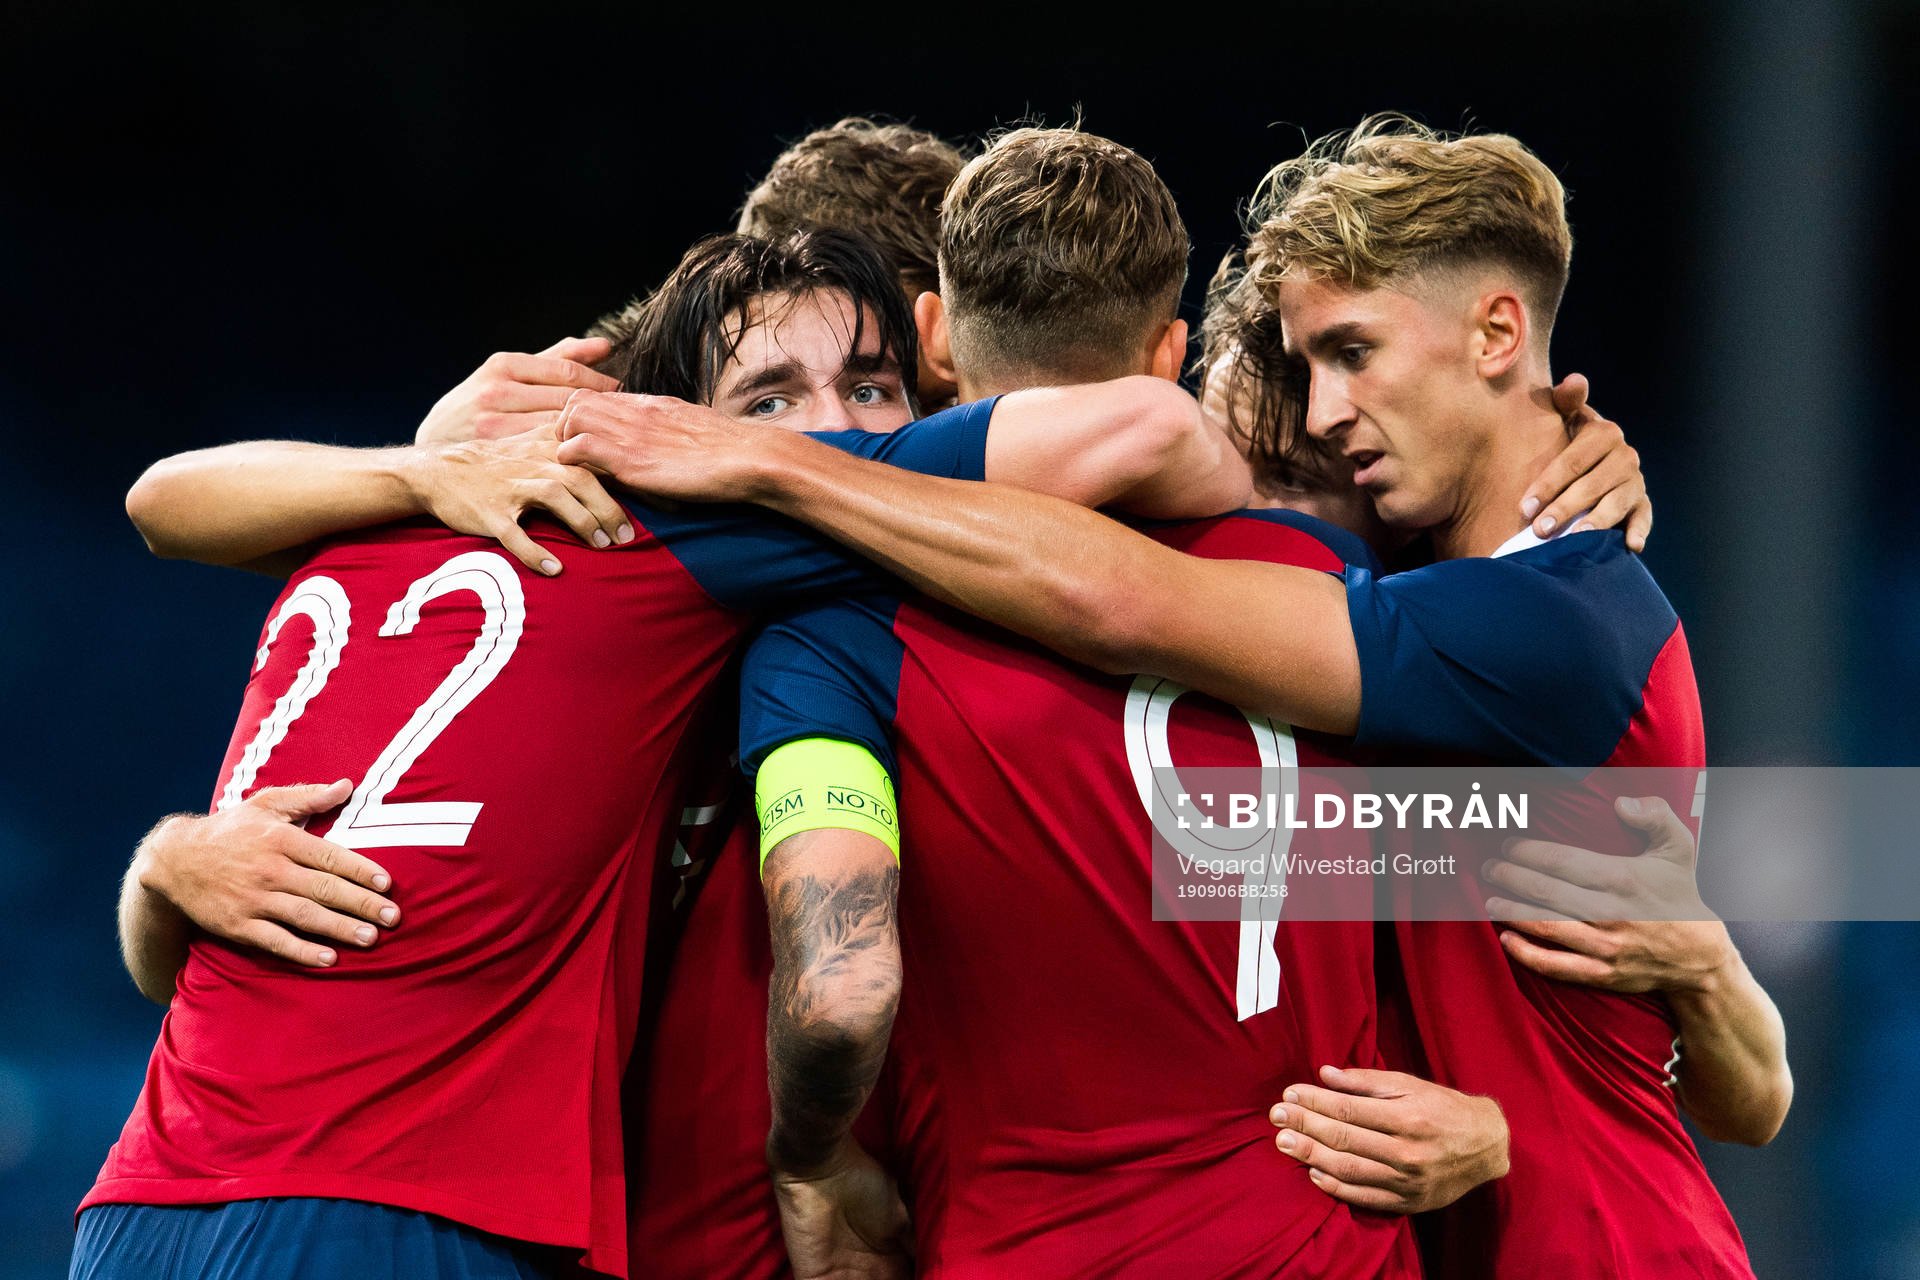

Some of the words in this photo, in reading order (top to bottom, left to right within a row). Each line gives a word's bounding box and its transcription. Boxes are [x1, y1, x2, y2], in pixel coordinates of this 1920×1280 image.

[217, 551, 526, 848] 22
[827, 791, 865, 809] NO
[870, 800, 893, 826] TO
[1124, 674, 1300, 1022] 9
